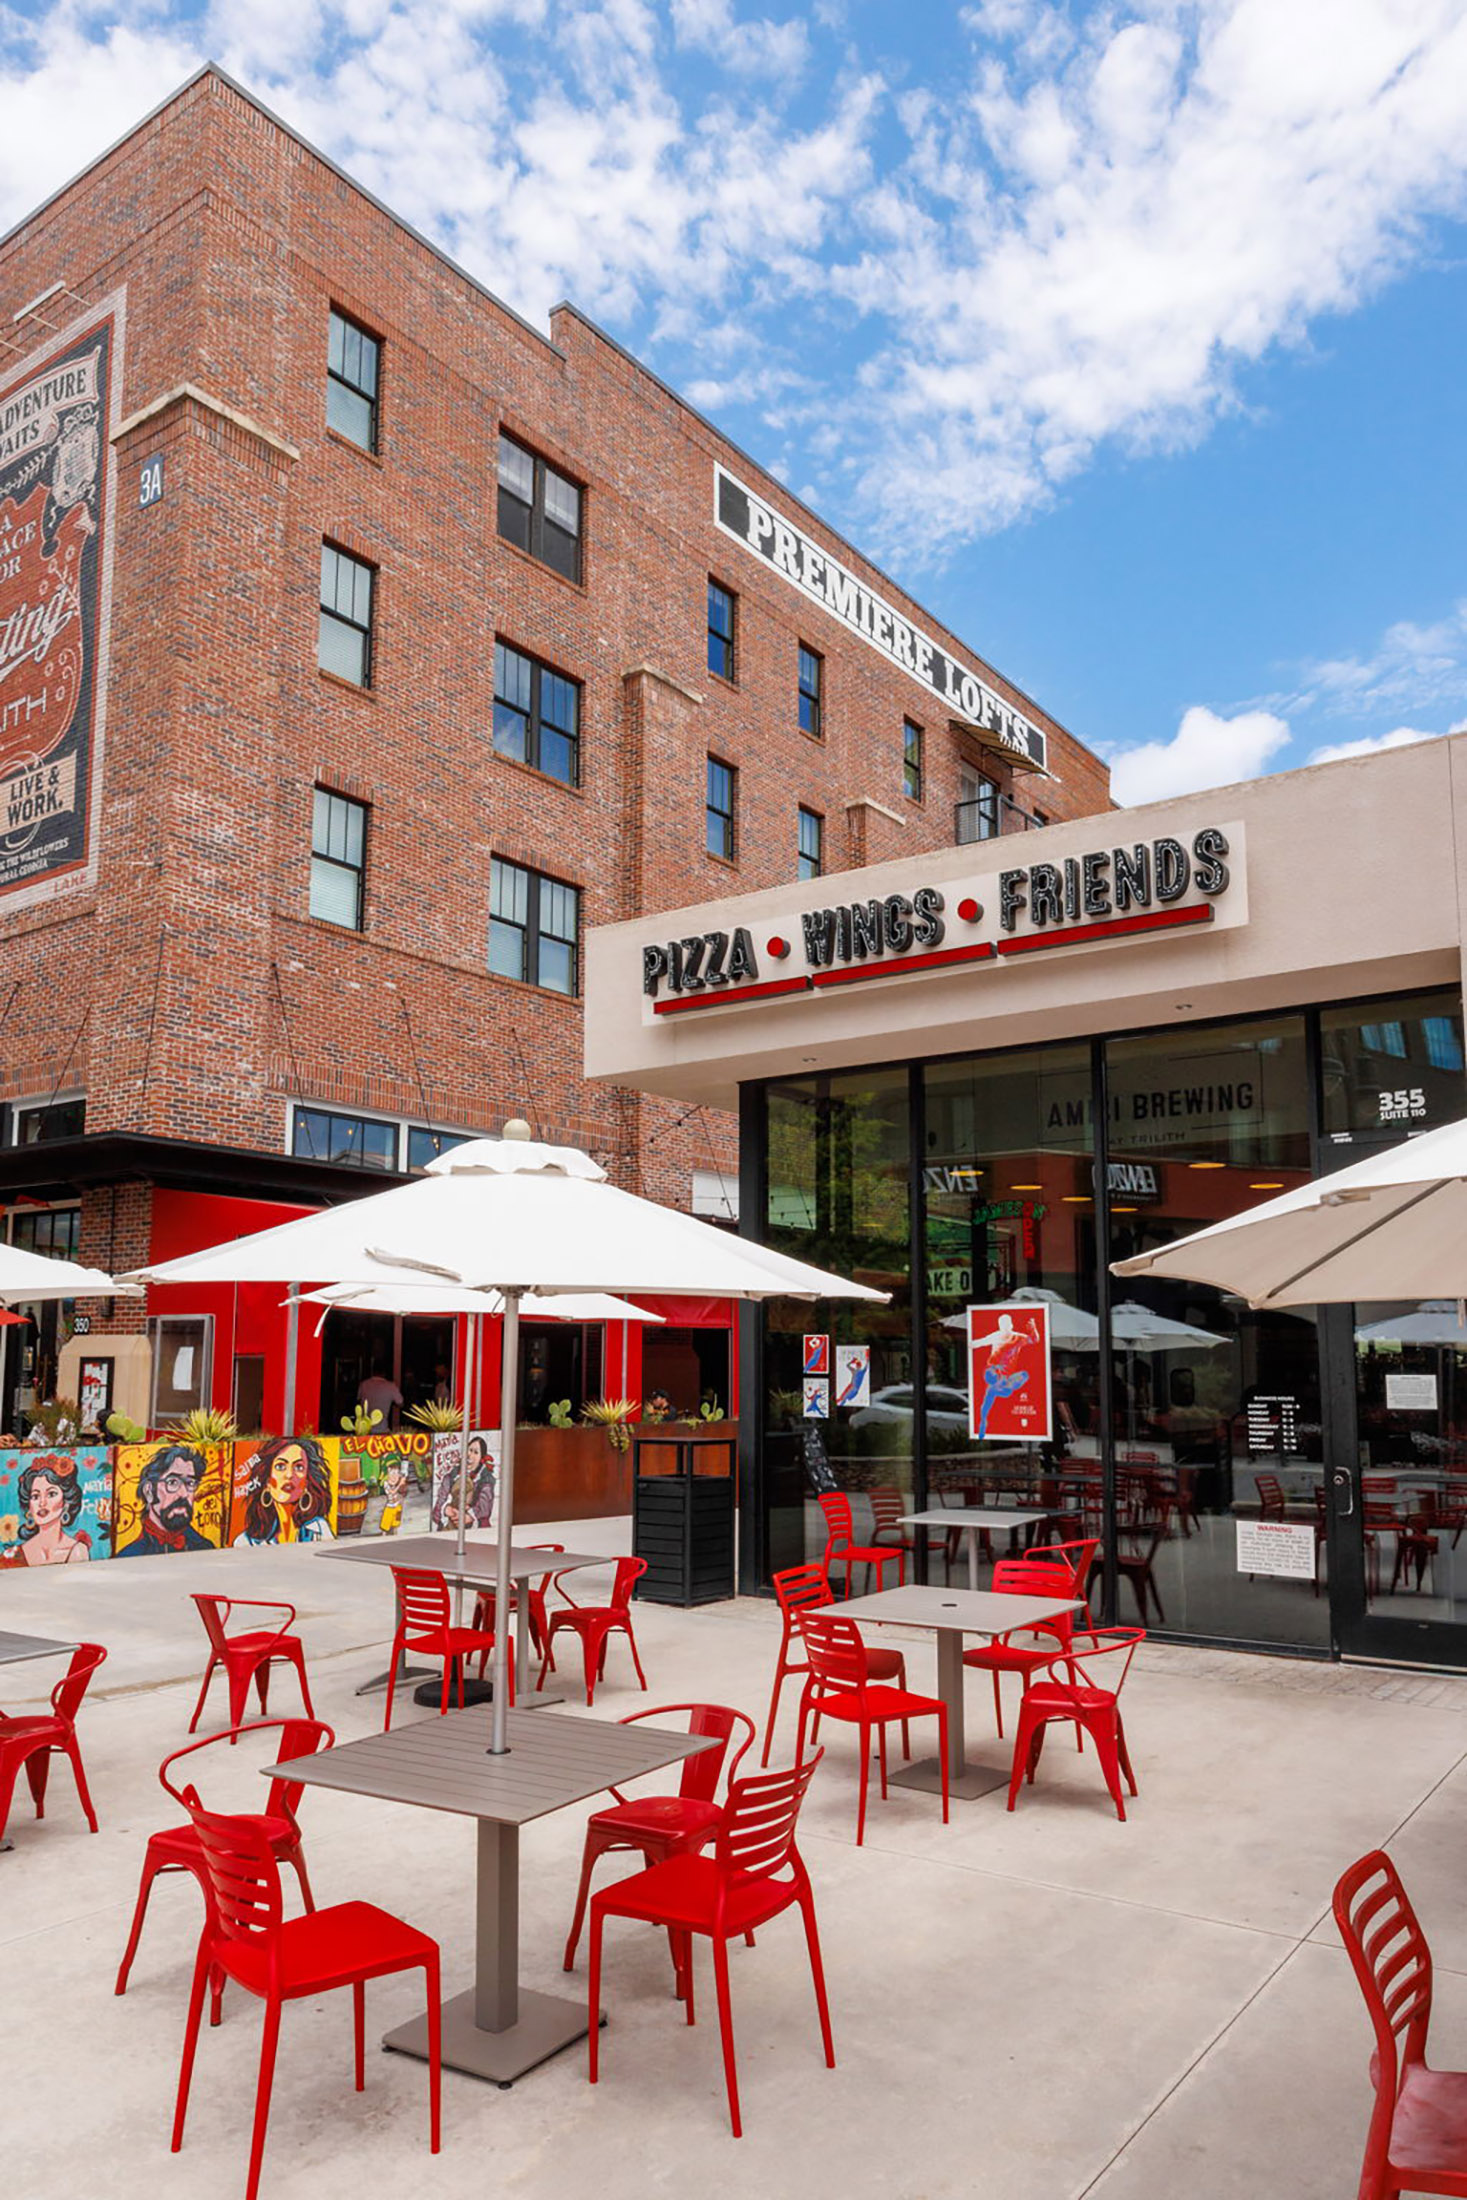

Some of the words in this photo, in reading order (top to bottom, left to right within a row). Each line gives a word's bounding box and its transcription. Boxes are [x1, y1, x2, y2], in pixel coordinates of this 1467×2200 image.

[140, 463, 161, 504] 3A
[0, 520, 37, 557] ACE
[0, 584, 73, 663] ting
[746, 496, 934, 684] PREMIERE
[944, 660, 1029, 756] LOFTS
[0, 687, 47, 732] ITH
[10, 771, 44, 802] LIVE
[47, 766, 59, 786] &
[7, 788, 63, 827] WORK.
[643, 926, 759, 997] PIZZA
[800, 886, 945, 968] WINGS
[999, 827, 1230, 932] FRIENDS
[1133, 1082, 1254, 1121] BREWING
[1378, 1088, 1426, 1111] 355
[1380, 1109, 1409, 1120] SUITE
[1410, 1108, 1427, 1118] 110
[74, 1317, 90, 1333] 350
[344, 1436, 367, 1454] EL
[1257, 1524, 1293, 1534] WARNING
